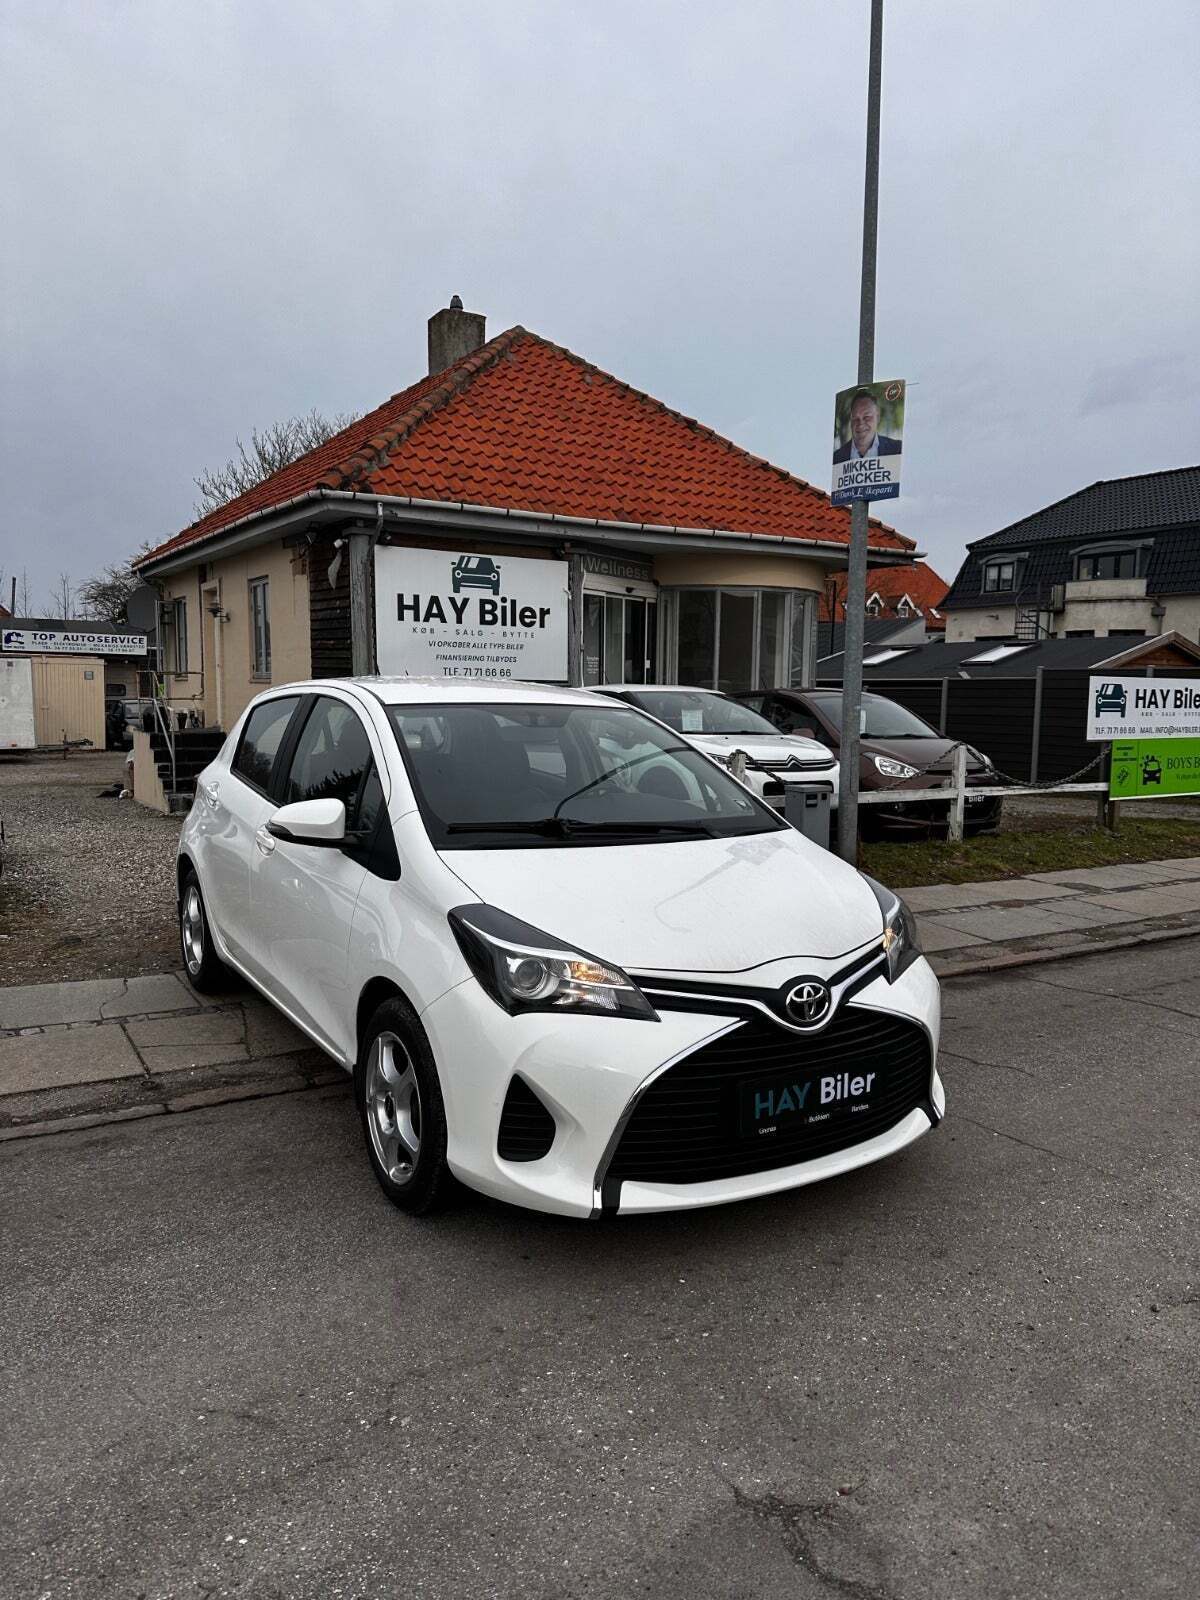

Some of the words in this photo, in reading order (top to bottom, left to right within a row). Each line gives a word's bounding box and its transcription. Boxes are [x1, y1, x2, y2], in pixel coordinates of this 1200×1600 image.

[843, 459, 884, 474] MIKKEL
[838, 471, 891, 488] DENCKER
[584, 556, 648, 579] Wellness
[397, 593, 470, 625] HAY
[479, 597, 551, 629] Biler
[32, 633, 56, 641] TOP
[63, 635, 145, 645] AUTOSERVICE
[456, 629, 483, 637] SALG
[435, 654, 484, 662] FINANSIERING
[443, 667, 460, 676] TLF.
[463, 668, 472, 676] 71
[474, 668, 483, 676] 71
[485, 669, 497, 677] 66
[500, 669, 511, 677] 66
[1135, 689, 1170, 709] HAY
[1174, 687, 1200, 709] Bile
[1167, 757, 1192, 769] BOYS
[755, 1082, 810, 1119] HAY
[820, 1072, 876, 1104] Biler
